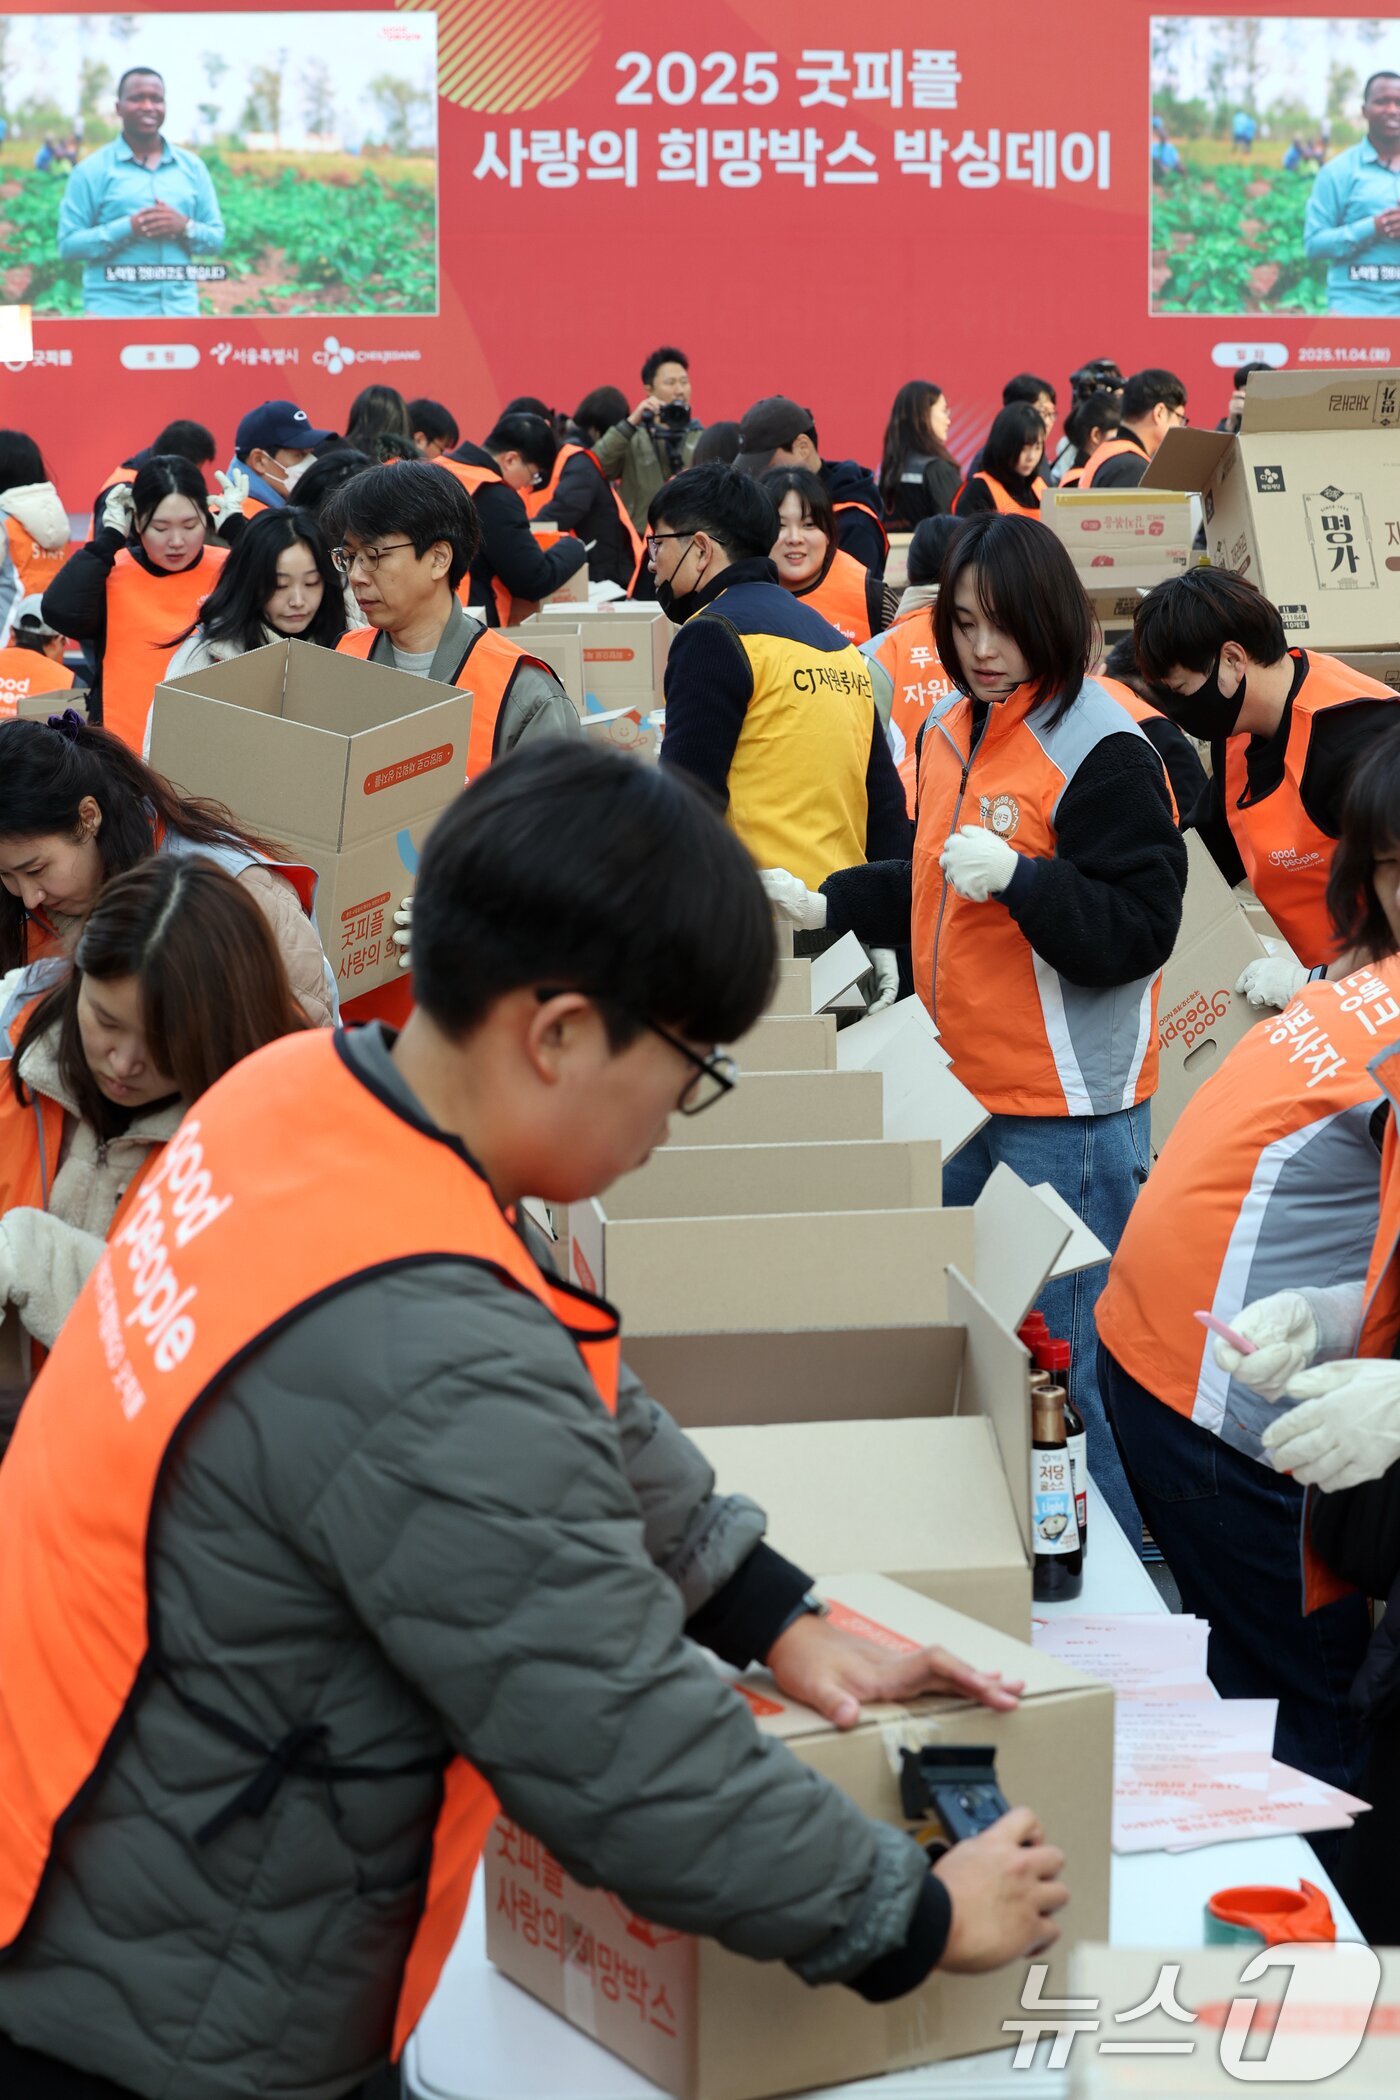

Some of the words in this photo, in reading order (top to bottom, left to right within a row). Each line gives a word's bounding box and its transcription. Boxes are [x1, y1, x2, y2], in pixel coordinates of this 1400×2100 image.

[615, 51, 780, 106] 2025
[797, 49, 962, 109] 굿피플
[473, 128, 639, 188] 사랑의
[657, 128, 879, 188] 희망박스
[894, 128, 1110, 189] 박싱데이
[232, 347, 299, 365] 서울특별시
[1328, 394, 1371, 412] 재래김
[1321, 514, 1360, 573] 명가
[793, 668, 817, 695] CJ
[1269, 847, 1296, 866] good
[1282, 852, 1320, 868] people
[341, 908, 385, 950] 굿피플
[338, 940, 381, 980] 사랑의
[1182, 989, 1231, 1049] good
[137, 1119, 234, 1248] good
[115, 1188, 198, 1373] people
[1039, 1464, 1065, 1480] 저당
[496, 1876, 566, 1966] 사랑의
